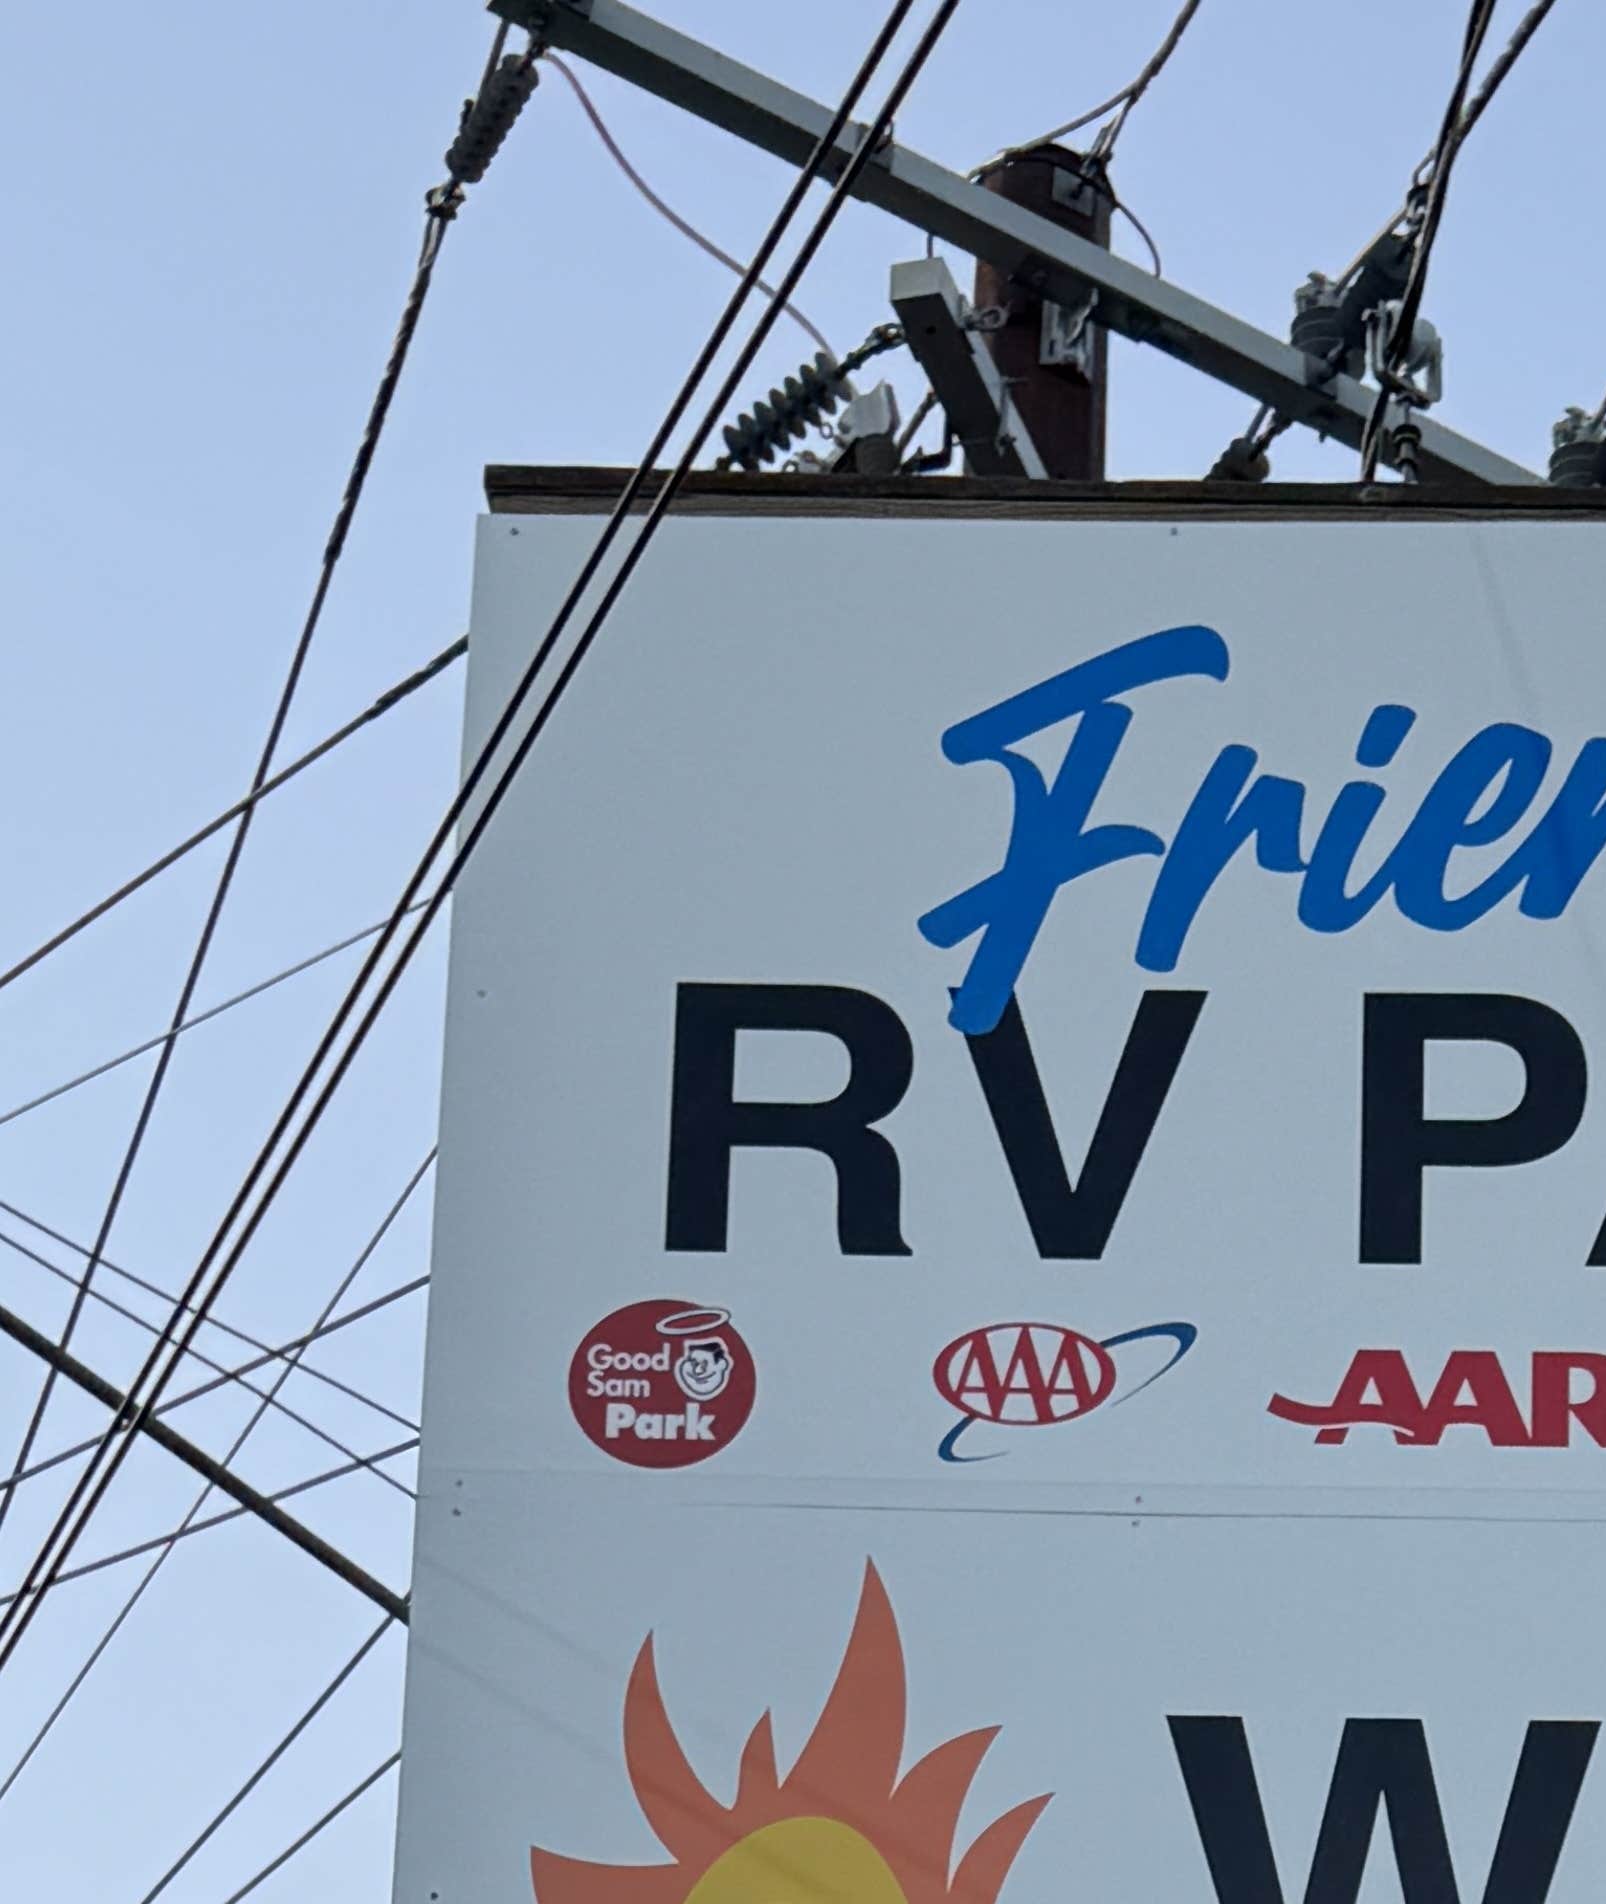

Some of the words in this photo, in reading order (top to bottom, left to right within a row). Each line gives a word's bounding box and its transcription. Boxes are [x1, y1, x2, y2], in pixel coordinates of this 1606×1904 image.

[665, 983, 1208, 1259] RV
[586, 1343, 670, 1373] Good
[938, 1325, 1112, 1423] AAA
[586, 1371, 651, 1398] Sam
[605, 1403, 716, 1441] Park
